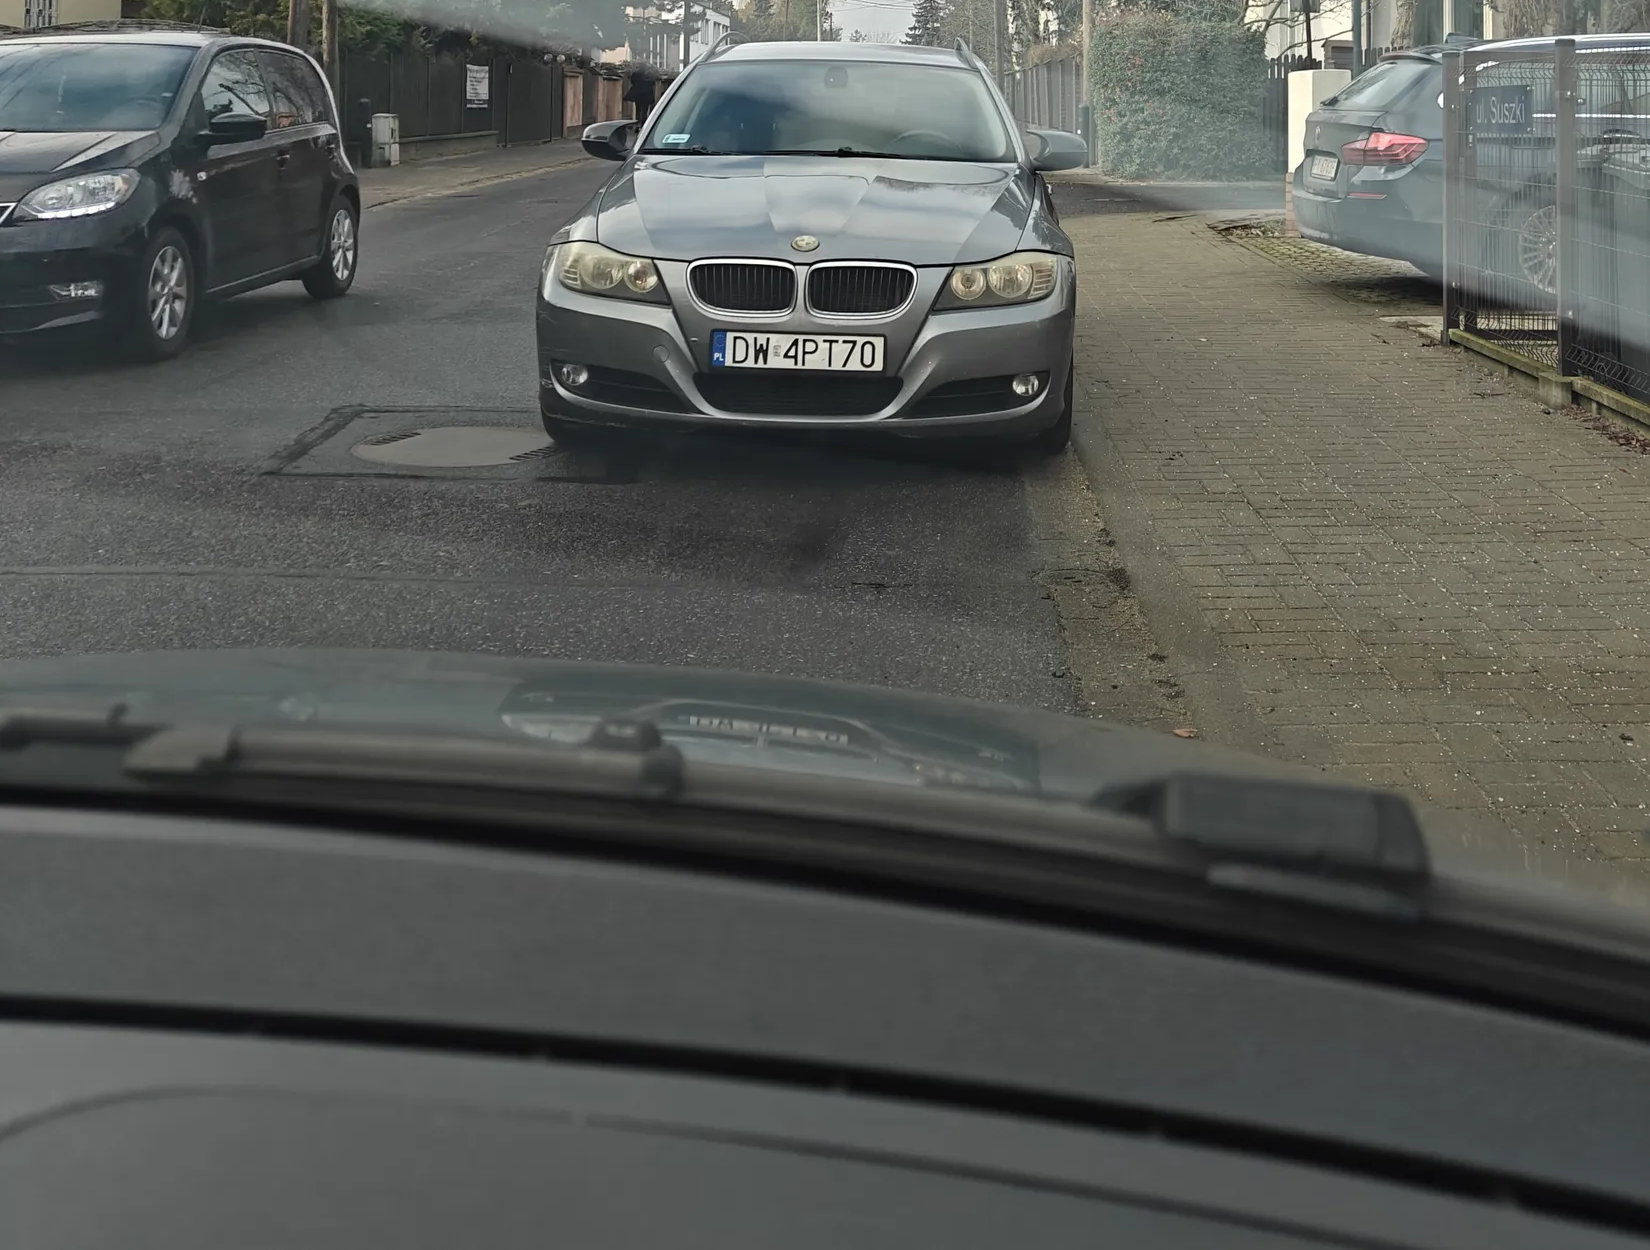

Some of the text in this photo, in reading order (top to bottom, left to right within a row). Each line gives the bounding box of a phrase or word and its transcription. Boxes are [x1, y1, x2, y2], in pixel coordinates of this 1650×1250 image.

[1476, 96, 1526, 124] ul. Suszki
[713, 352, 724, 361] PL
[732, 335, 877, 369] DW 4PT70
